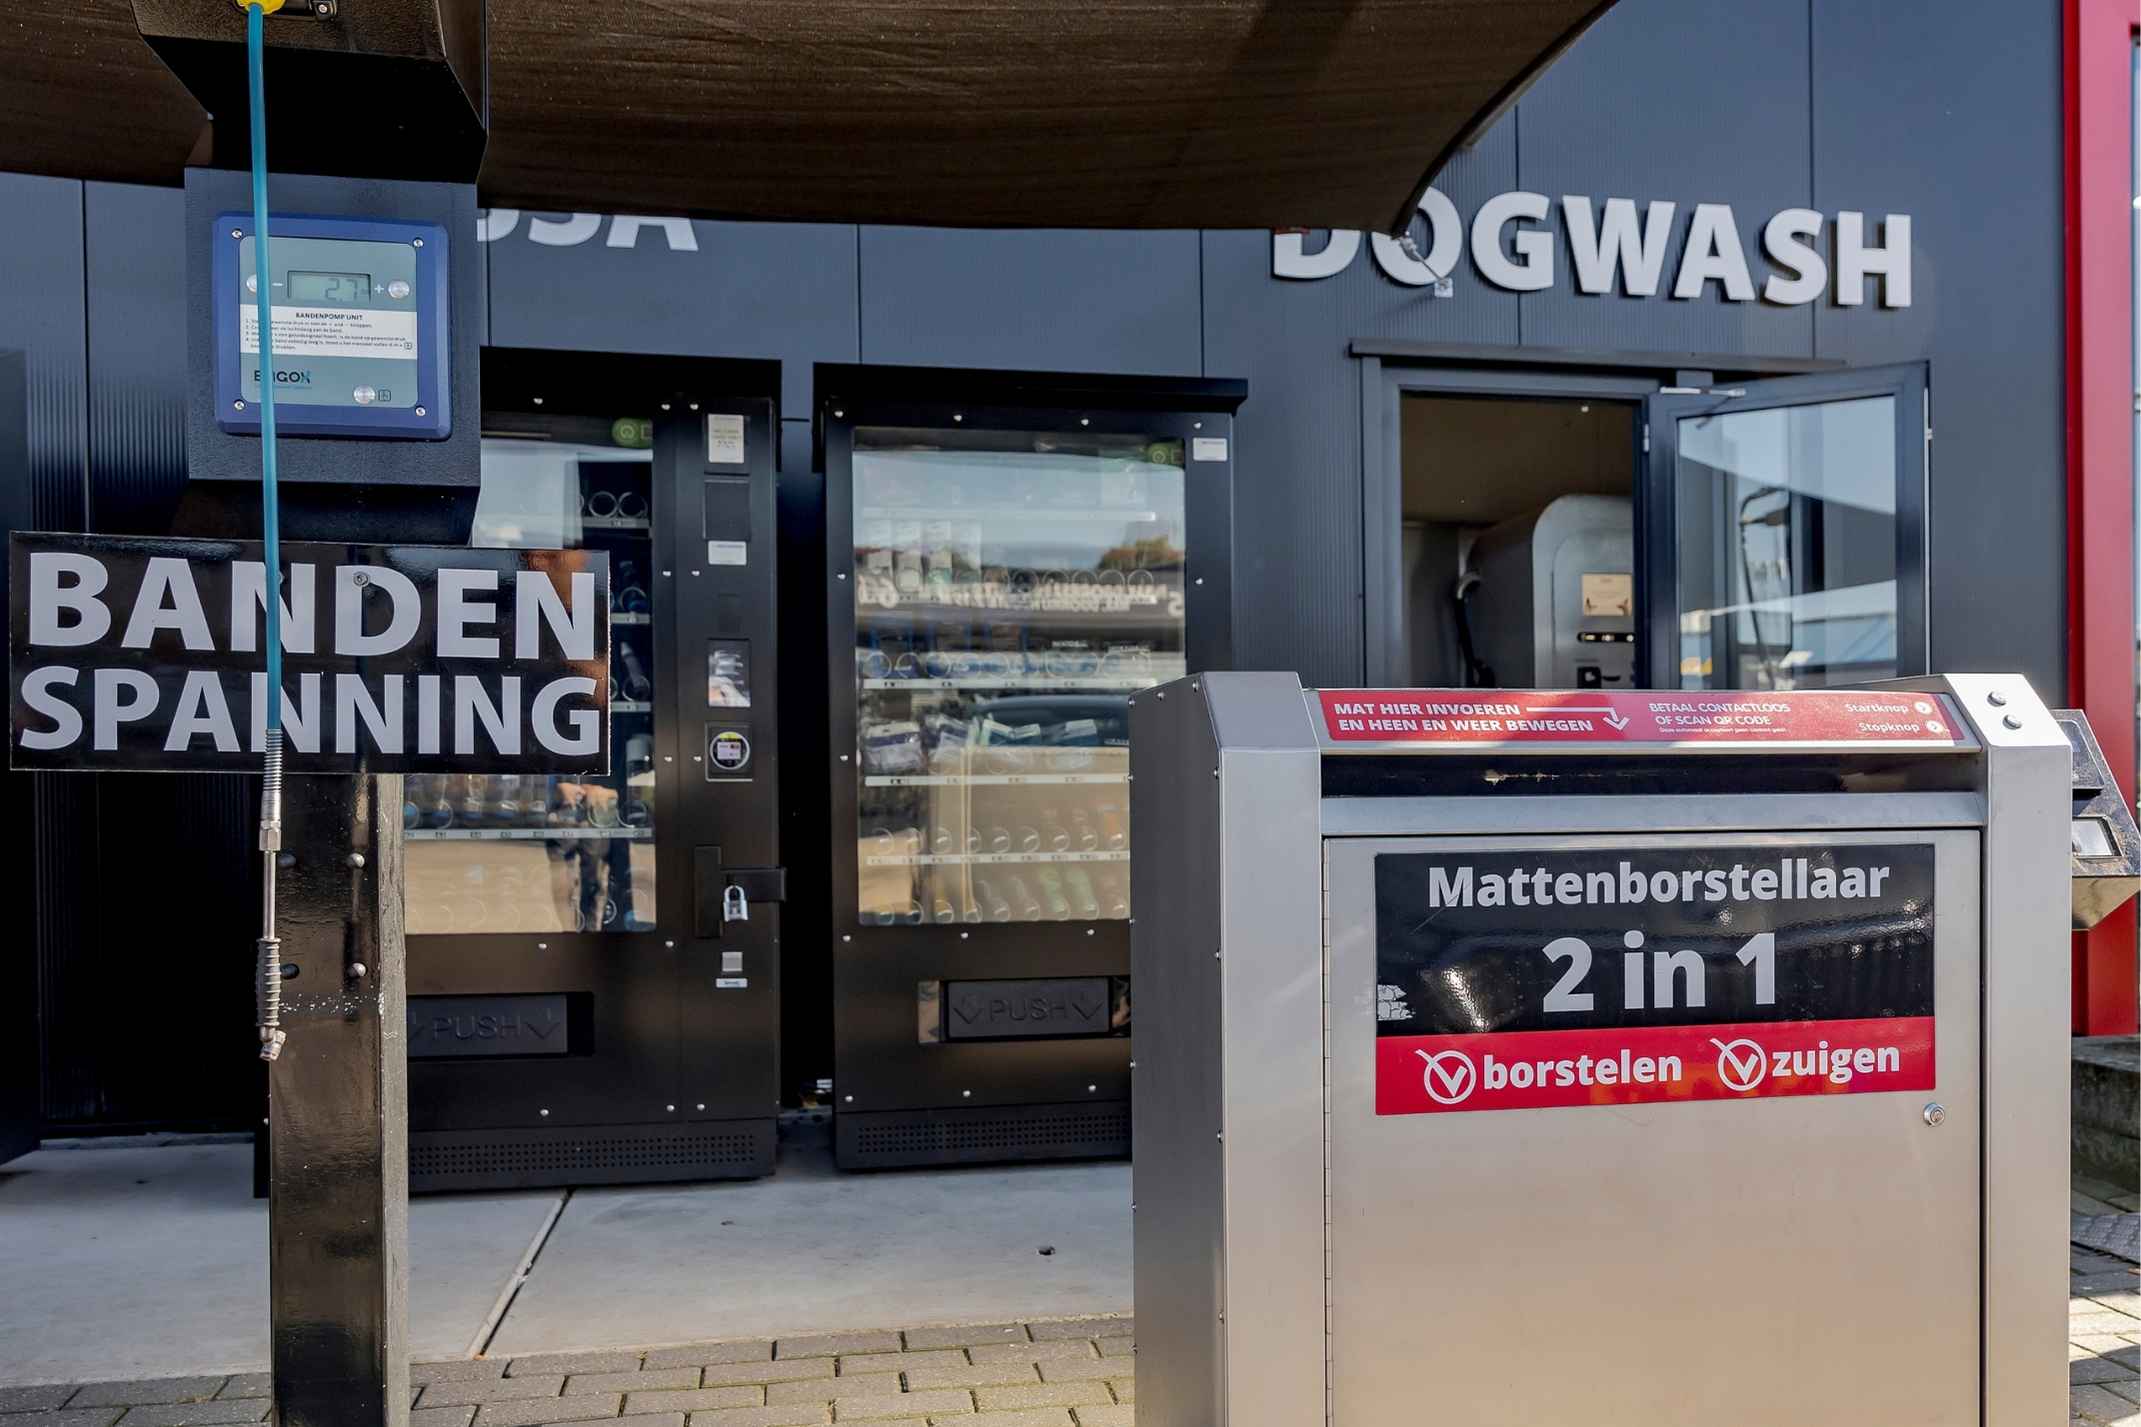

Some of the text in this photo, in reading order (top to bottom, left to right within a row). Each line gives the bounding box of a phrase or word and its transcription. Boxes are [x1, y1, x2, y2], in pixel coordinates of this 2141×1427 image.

[1273, 186, 1912, 308] DOGWASH
[346, 313, 363, 321] UNIT
[254, 369, 311, 384] EGOX
[28, 551, 595, 661] BANDEN
[19, 664, 601, 756] SPANNING
[1334, 703, 1521, 716] MAT HIER INVOEREN
[1648, 703, 1791, 713] BETAAL CONTACTLOOS
[1845, 702, 1909, 714] Startknop
[1338, 719, 1594, 732] EN HEEN EN WEER BEWEGEN
[1655, 715, 1772, 725] OF SCAN QR CODE
[1859, 722, 1920, 734] Stopknop
[1427, 858, 1891, 908] Mattenborstellaar
[1541, 930, 1777, 1013] 2 in 1
[990, 997, 1068, 1022] PUSH
[432, 1015, 522, 1041] PUSH
[1483, 1041, 1901, 1090] borstelen zuigen
